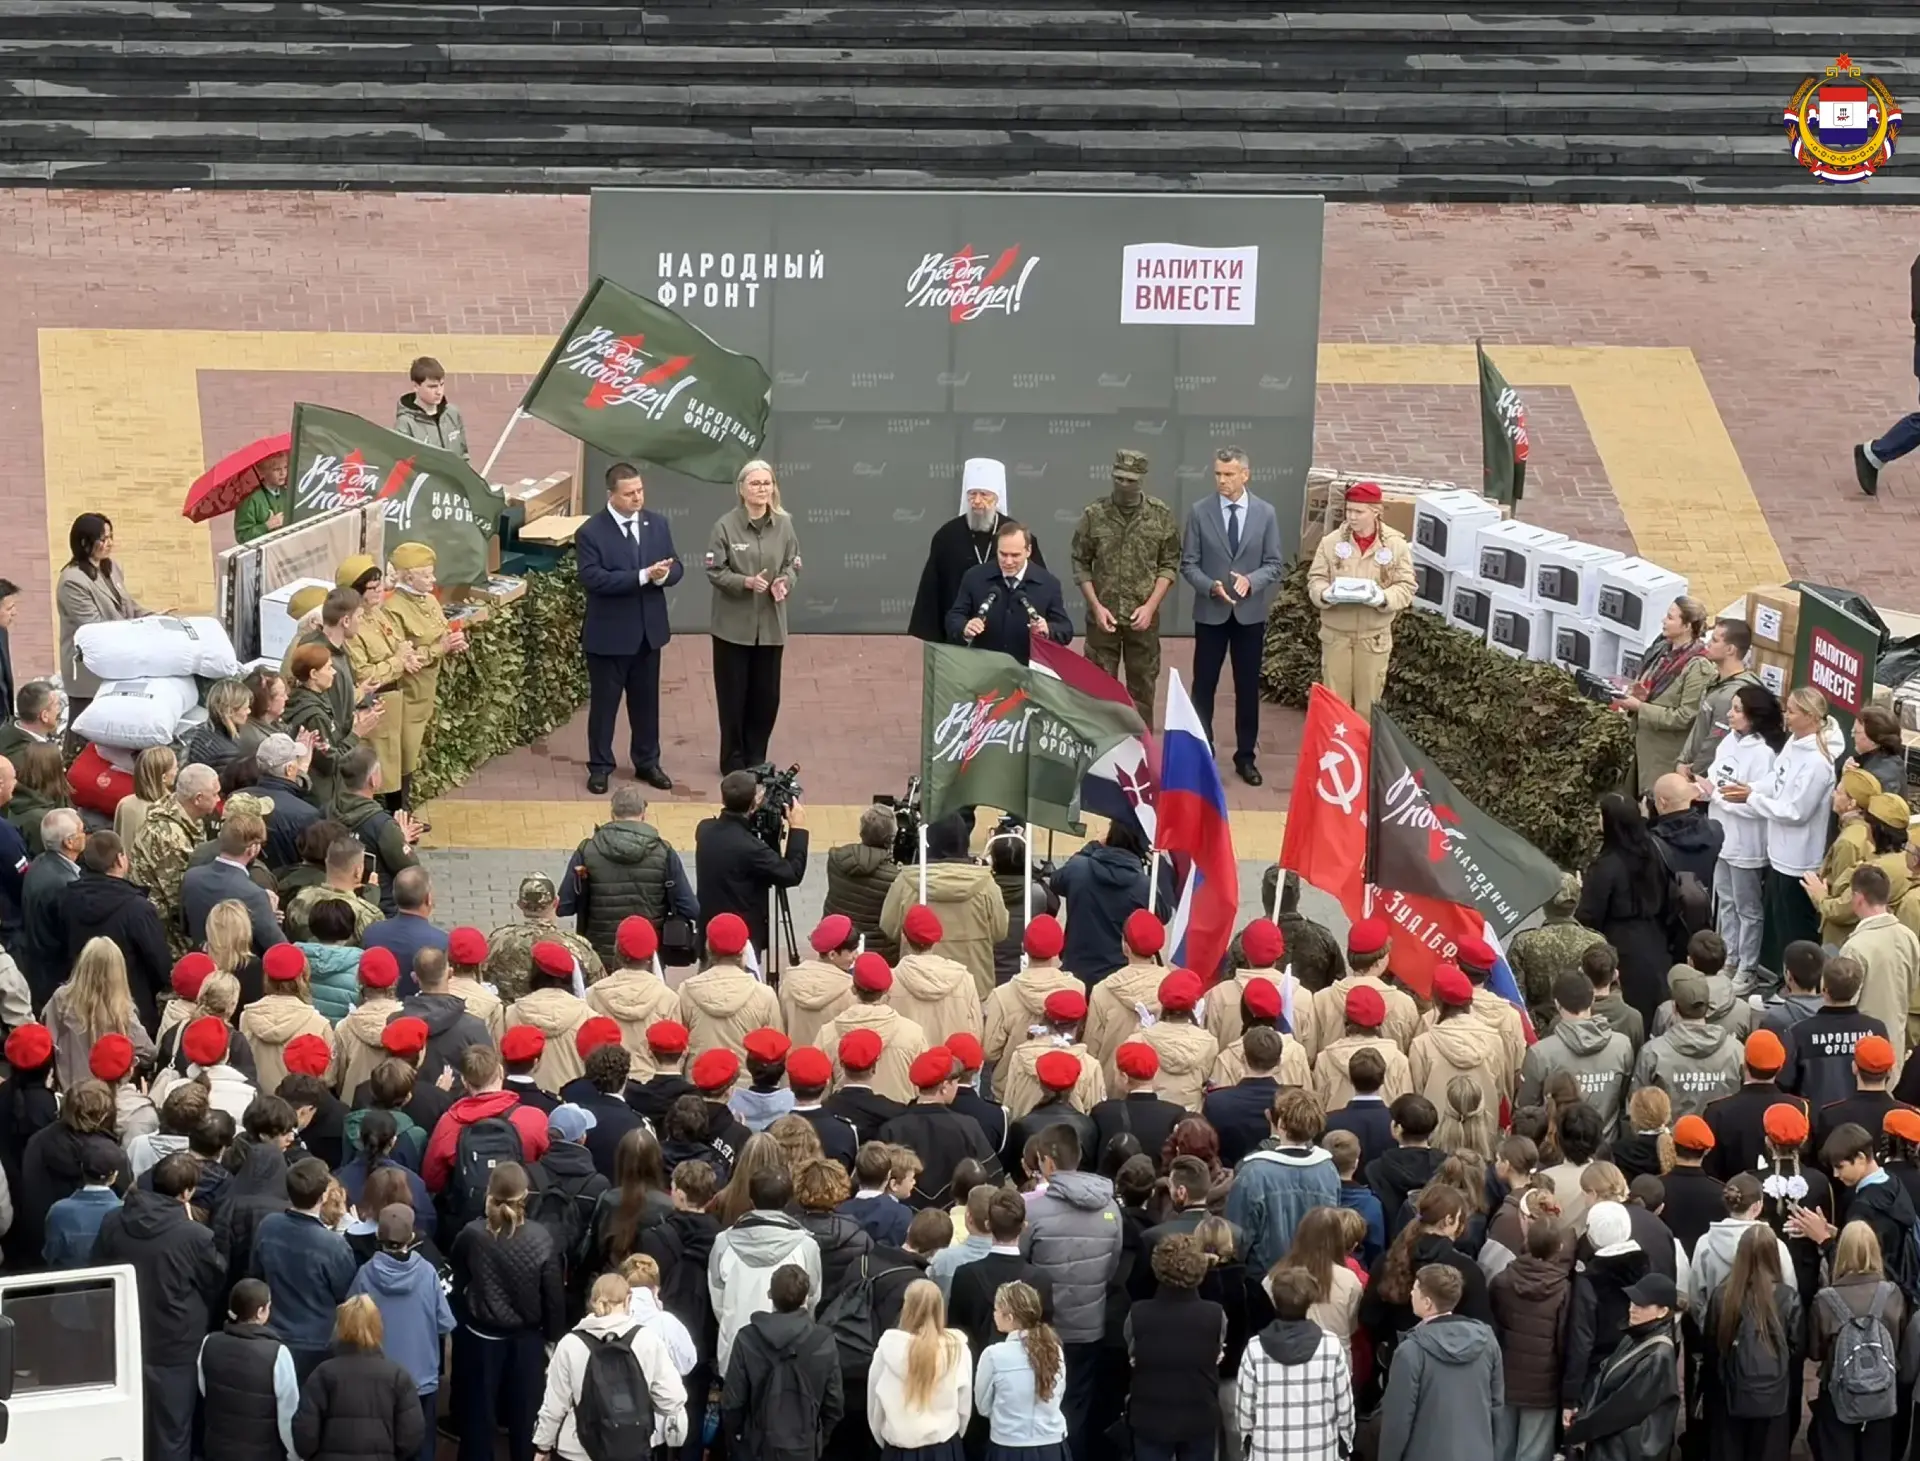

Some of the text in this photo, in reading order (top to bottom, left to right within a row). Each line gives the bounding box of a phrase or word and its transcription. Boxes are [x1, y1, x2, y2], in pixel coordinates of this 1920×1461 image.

[658, 250, 824, 281] НАРОДНЫЙ
[1137, 258, 1244, 280] НАПИТКИ
[657, 282, 760, 308] ФРОНТ
[917, 256, 1040, 320] победы!
[1135, 285, 1242, 311] ВМЕСТЕ
[569, 356, 698, 420] победы!
[683, 411, 728, 444] ФРОНТ
[687, 397, 758, 448] НАРОДНЫЙ
[431, 506, 474, 523] ФРОН
[1814, 635, 1859, 677] НАПИТКИ
[1812, 659, 1857, 705] ВМЕСТЕ
[1453, 846, 1520, 924] НАРОДНЫЙ
[1824, 1044, 1856, 1055] ФРОН
[1580, 1082, 1605, 1093] РОНТ
[1673, 1071, 1726, 1083] НАРОДНЫЙ
[1682, 1082, 1716, 1092] ФРОНТ
